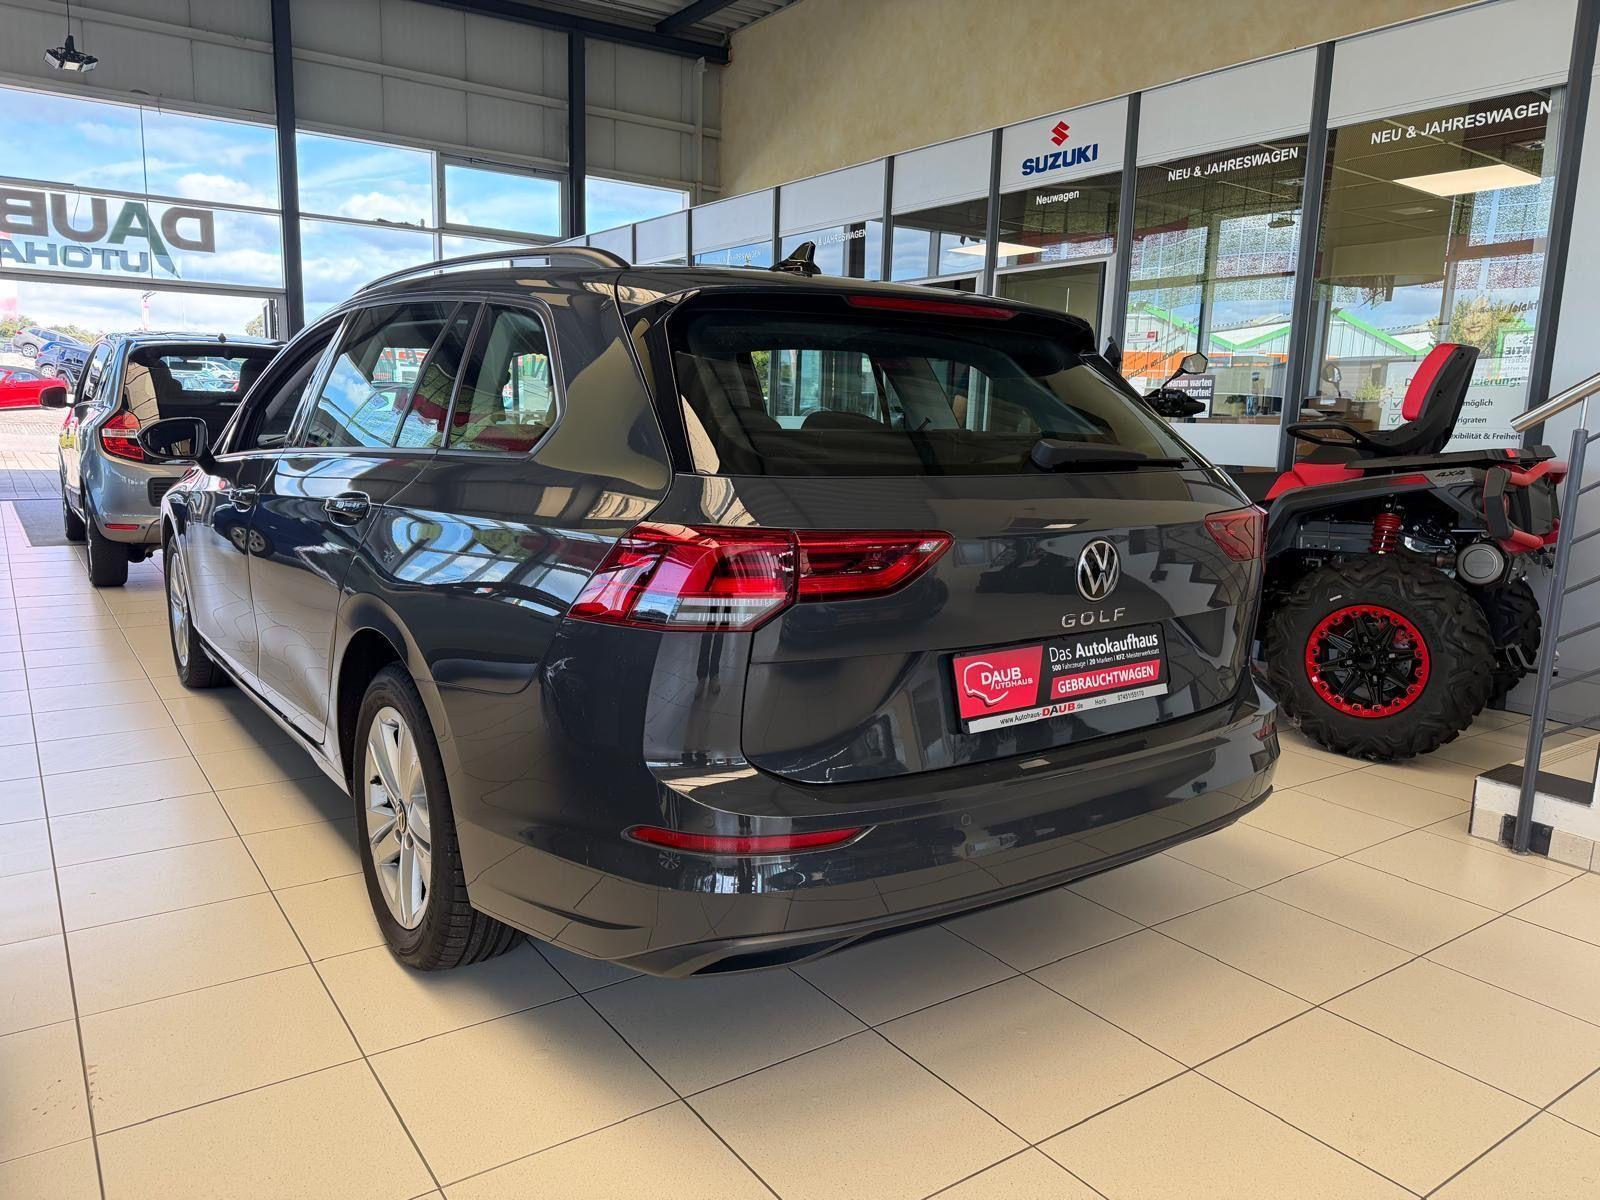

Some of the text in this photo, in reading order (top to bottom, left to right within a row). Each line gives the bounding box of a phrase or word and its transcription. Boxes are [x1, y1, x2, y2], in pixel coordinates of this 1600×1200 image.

[1371, 100, 1552, 145] NEU & JAHRESWAGEN
[1022, 143, 1098, 176] SUZUKI
[1168, 147, 1298, 181] NEU & JAHRESWAGEN
[1036, 191, 1080, 205] Neuwagen
[1190, 378, 1213, 388] warten
[1471, 377, 1521, 388] zierung:
[1457, 415, 1487, 426] rigraten
[1451, 431, 1521, 441] exibilität & Freiheit
[1061, 607, 1126, 628] GOLF
[1048, 633, 1159, 663] Das Autokaufhaus
[1051, 664, 1062, 672] 500
[1062, 660, 1086, 670] Fahrzeuge
[1096, 656, 1113, 665] Marken
[981, 667, 1022, 690] DAUB
[1057, 665, 1154, 693] GEBRAUCHTWAGEN
